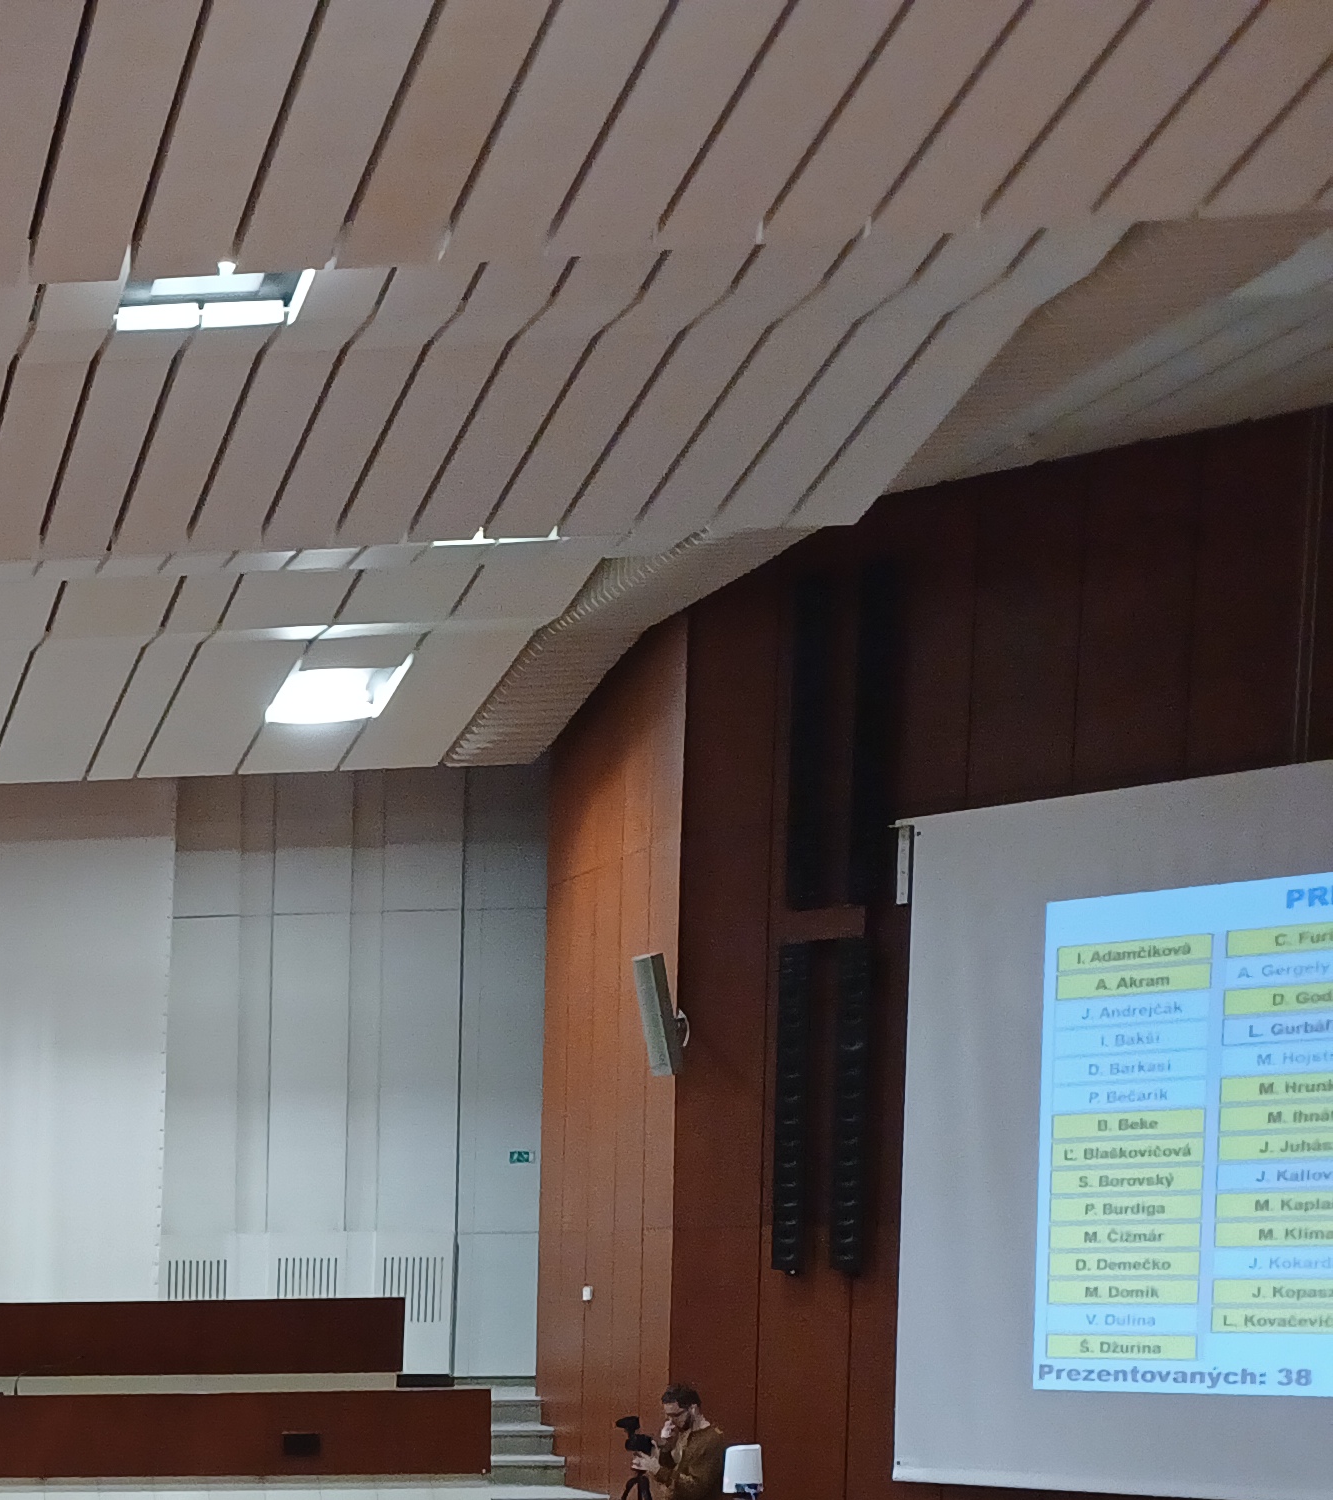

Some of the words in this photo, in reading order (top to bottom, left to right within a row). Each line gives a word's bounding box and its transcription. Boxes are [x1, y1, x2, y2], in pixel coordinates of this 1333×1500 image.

[1286, 885, 1333, 909] PR
[1116, 975, 1171, 990] Akram
[1118, 1117, 1159, 1131] Beke
[1267, 1111, 1289, 1124] M.
[1083, 1142, 1192, 1160] Blaškovičová
[1259, 1141, 1274, 1153] J.
[1078, 1175, 1094, 1188] S.
[1099, 1172, 1174, 1188] Borovský
[1085, 1203, 1097, 1216] P.
[1103, 1202, 1165, 1216] Burdiga
[1254, 1199, 1274, 1212] M.
[1280, 1198, 1333, 1213] Kapla
[1083, 1231, 1101, 1243] M.
[1258, 1228, 1278, 1241] M.
[1075, 1259, 1091, 1271] D.
[1097, 1258, 1171, 1271] Demečko
[1248, 1257, 1262, 1269] J.
[1085, 1286, 1102, 1298] M.
[1251, 1287, 1265, 1299] J.
[1086, 1314, 1098, 1326] V.
[1100, 1340, 1162, 1355] Džurina
[1038, 1364, 1267, 1389] Prezentovaných:
[1277, 1368, 1313, 1387] 38
